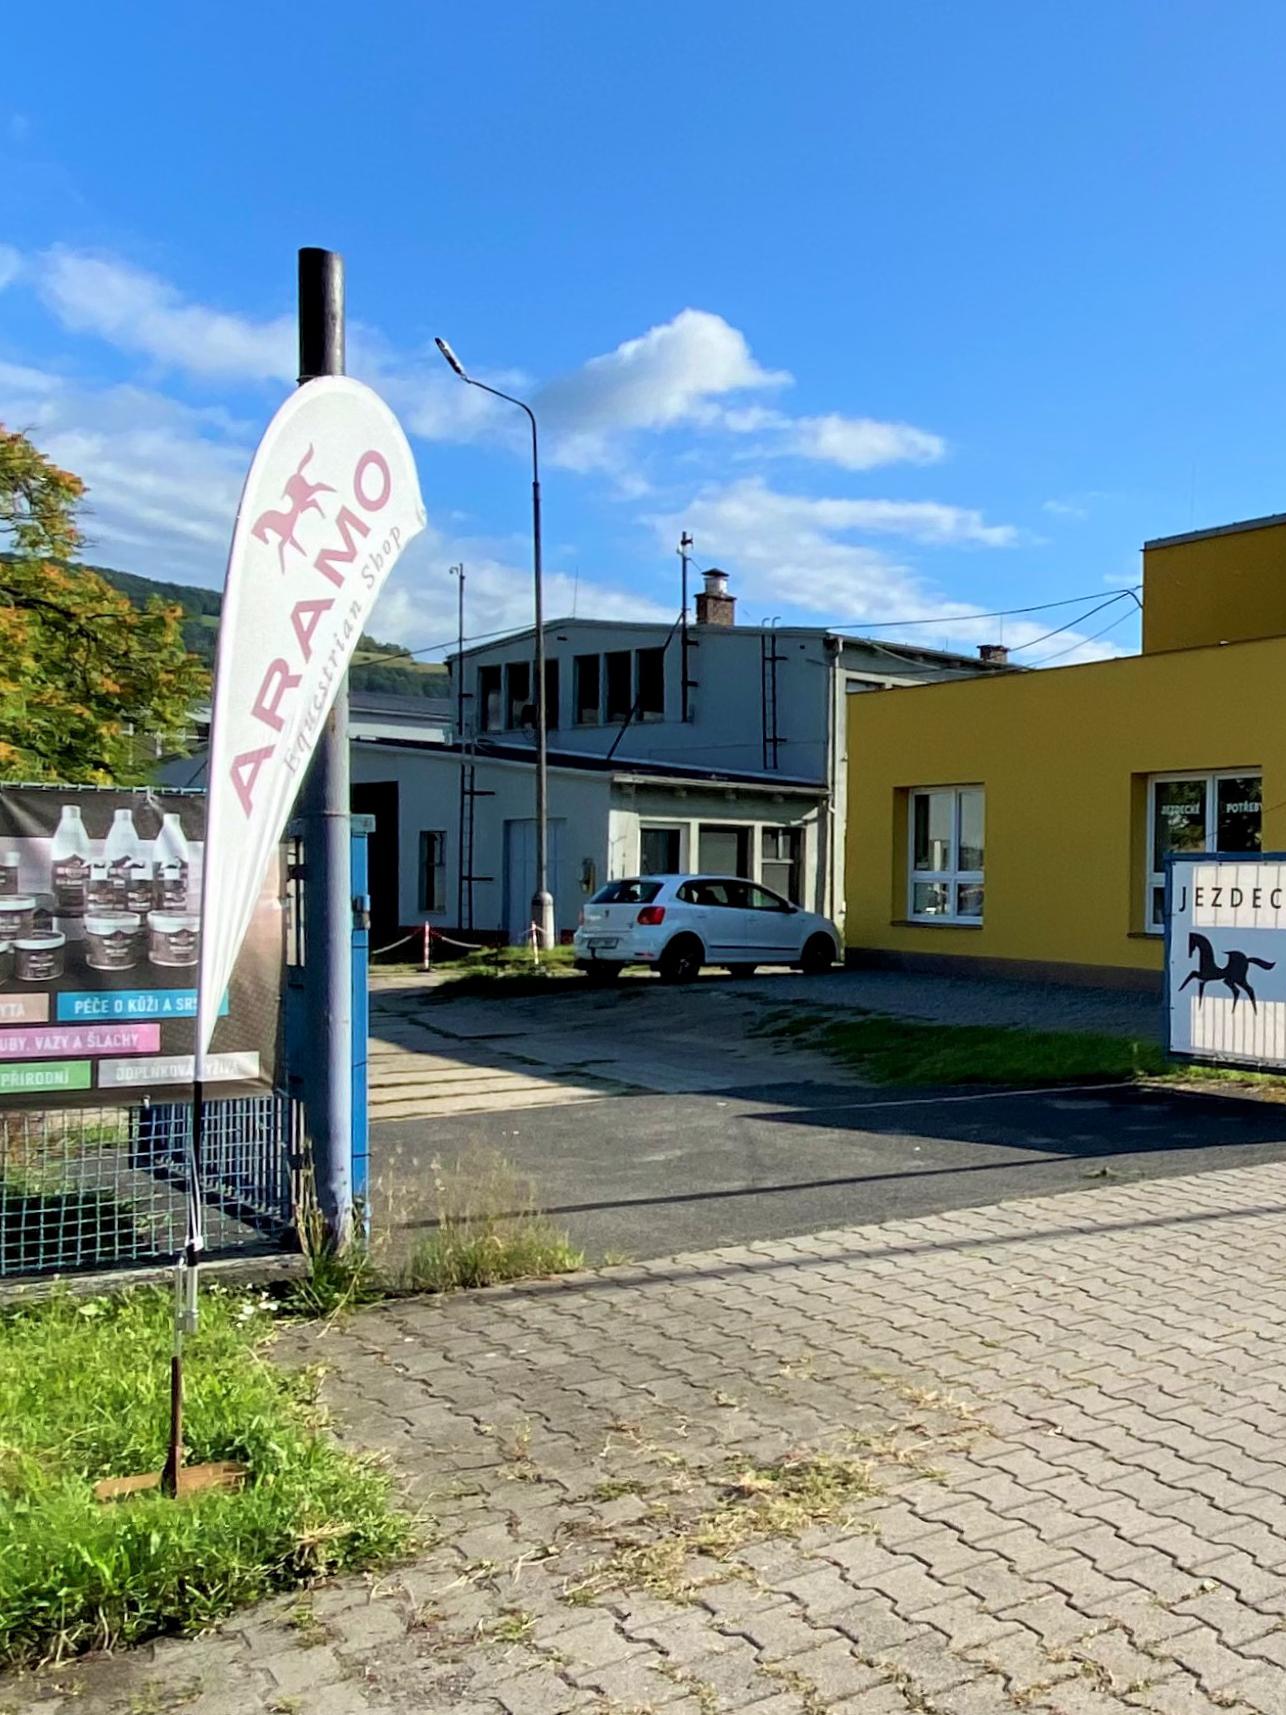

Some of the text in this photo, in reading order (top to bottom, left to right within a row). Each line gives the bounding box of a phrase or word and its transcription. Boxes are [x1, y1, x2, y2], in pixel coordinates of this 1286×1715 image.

[229, 449, 392, 819] ARAMO
[283, 525, 401, 775] Equestrian Shop
[73, 1035, 82, 1049] A
[87, 1031, 140, 1049] ŠLACHY
[114, 999, 123, 1013] O
[128, 996, 158, 1013] KŮŽI
[163, 997, 172, 1012] A
